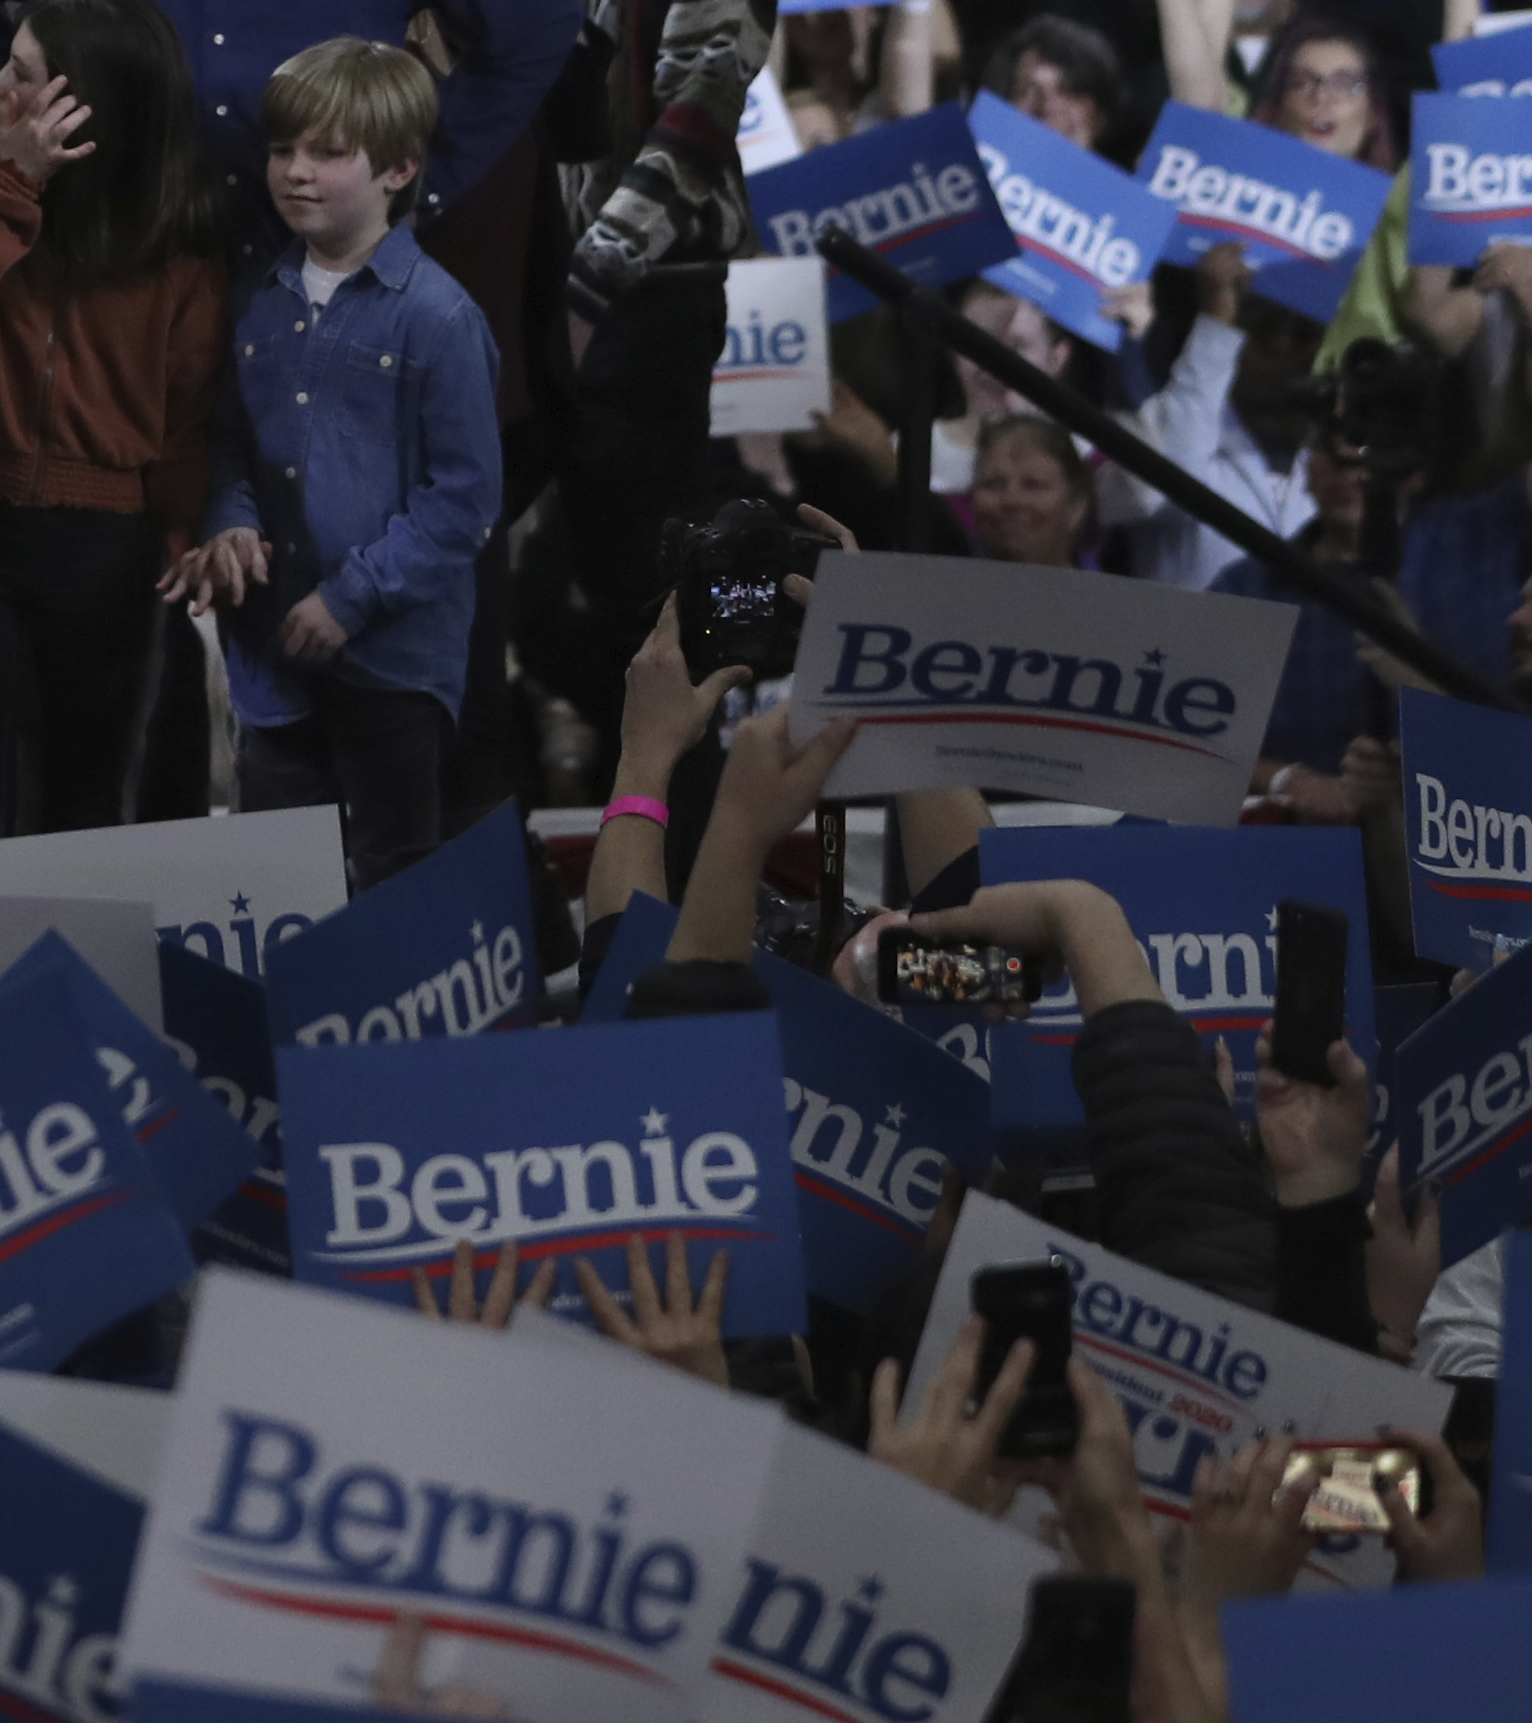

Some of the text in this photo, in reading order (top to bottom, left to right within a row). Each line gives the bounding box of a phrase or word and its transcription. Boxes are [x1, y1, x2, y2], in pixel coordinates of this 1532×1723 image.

[1148, 146, 1352, 261] Bernie
[824, 624, 1235, 738] Bernie
[823, 814, 836, 874] EOS
[318, 1107, 758, 1247] Bernie
[1169, 1392, 1235, 1434] 2020
[198, 1406, 698, 1652] Bernie
